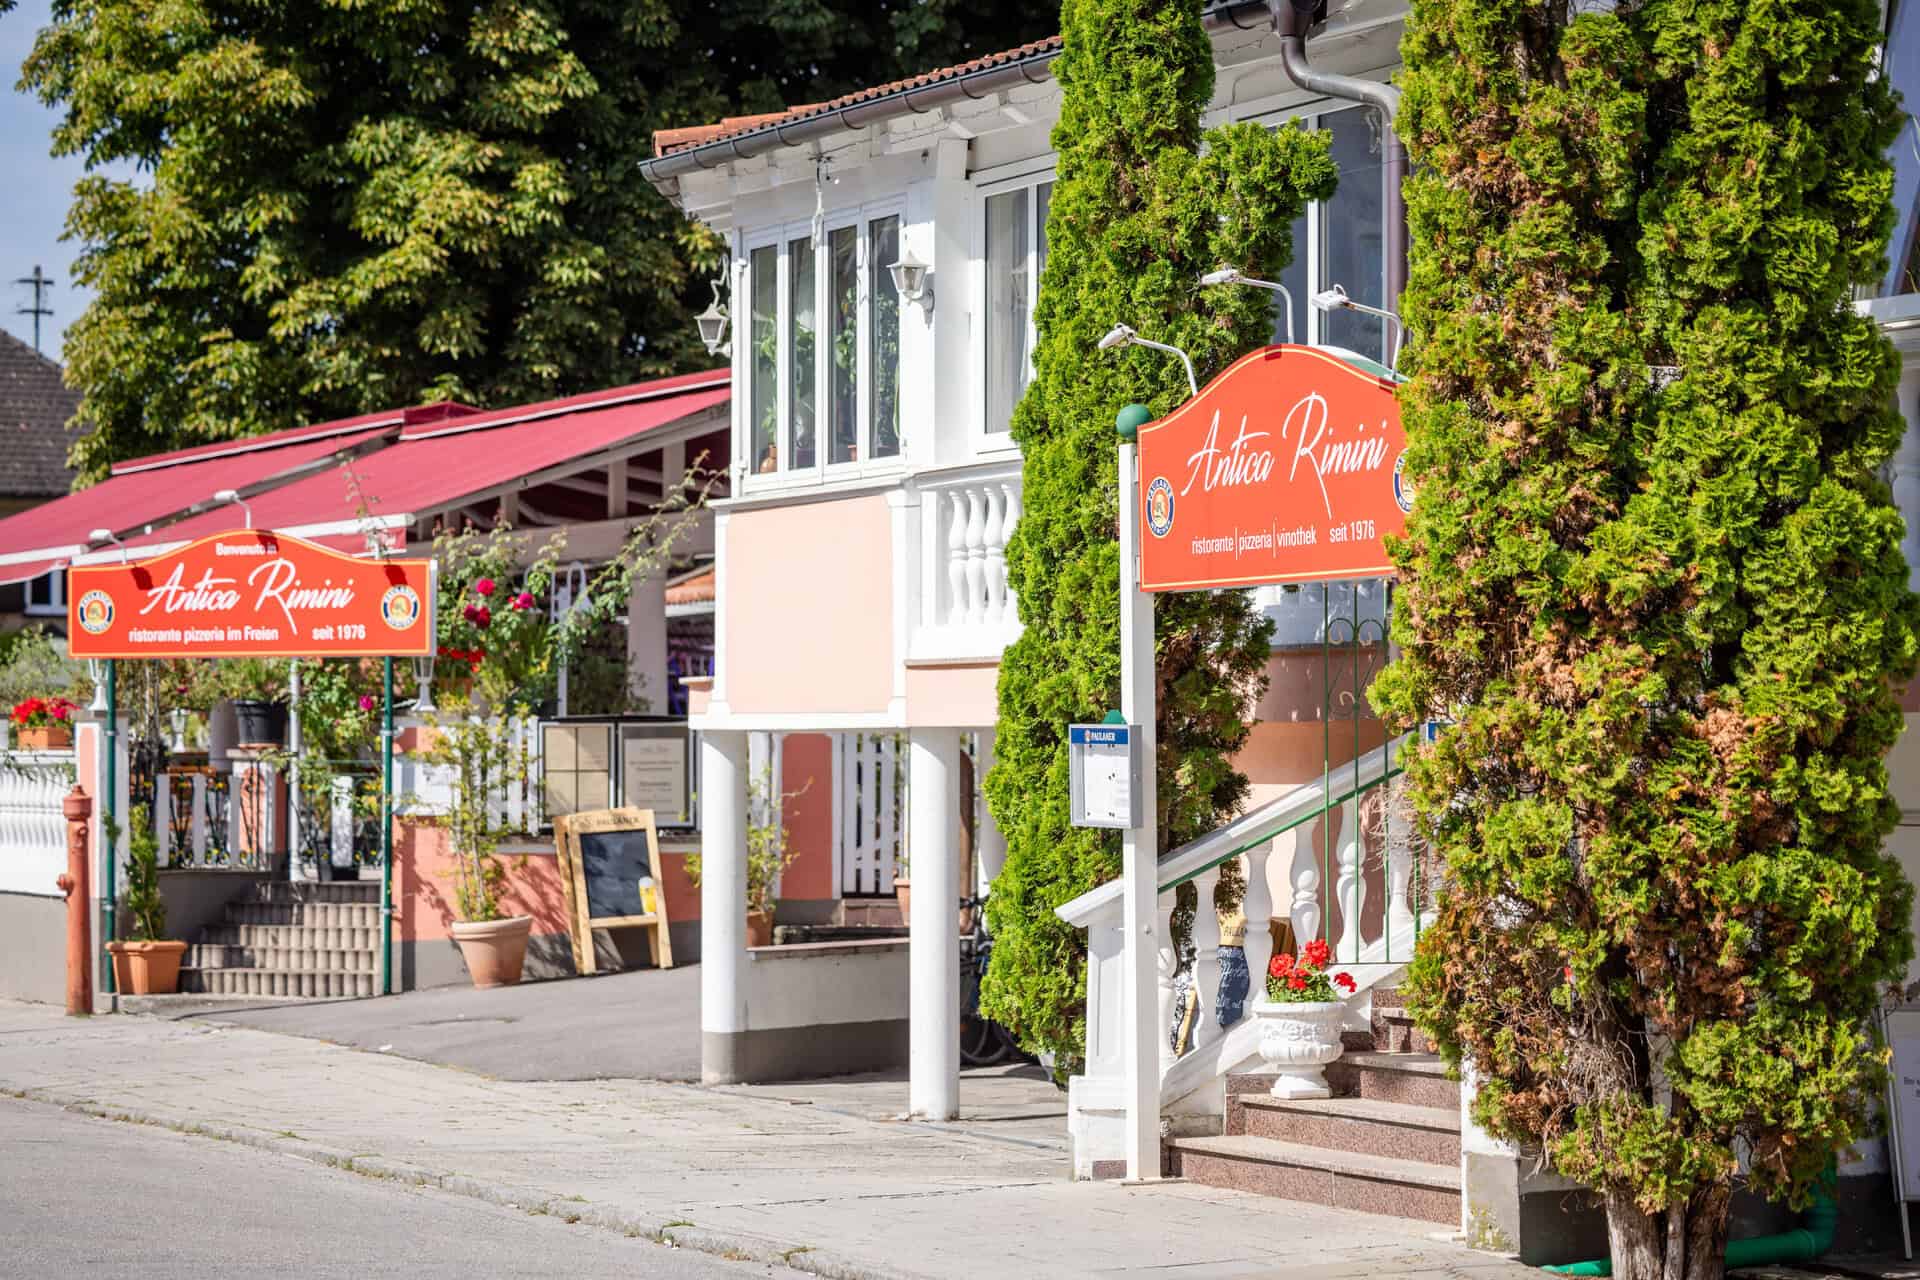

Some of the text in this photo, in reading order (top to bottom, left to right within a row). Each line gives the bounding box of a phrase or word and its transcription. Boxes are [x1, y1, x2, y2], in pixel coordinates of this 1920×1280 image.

[1181, 391, 1389, 520] Antica Rimini
[1191, 519, 1375, 555] ristorante pizzeria vinothek seit 1976
[139, 557, 355, 635] Antica Rimini
[128, 626, 182, 643] ristorante
[183, 626, 225, 645] pizzeria
[227, 626, 242, 641] im
[243, 625, 279, 641] Freien
[312, 625, 334, 641] seit
[337, 624, 366, 640] 1976
